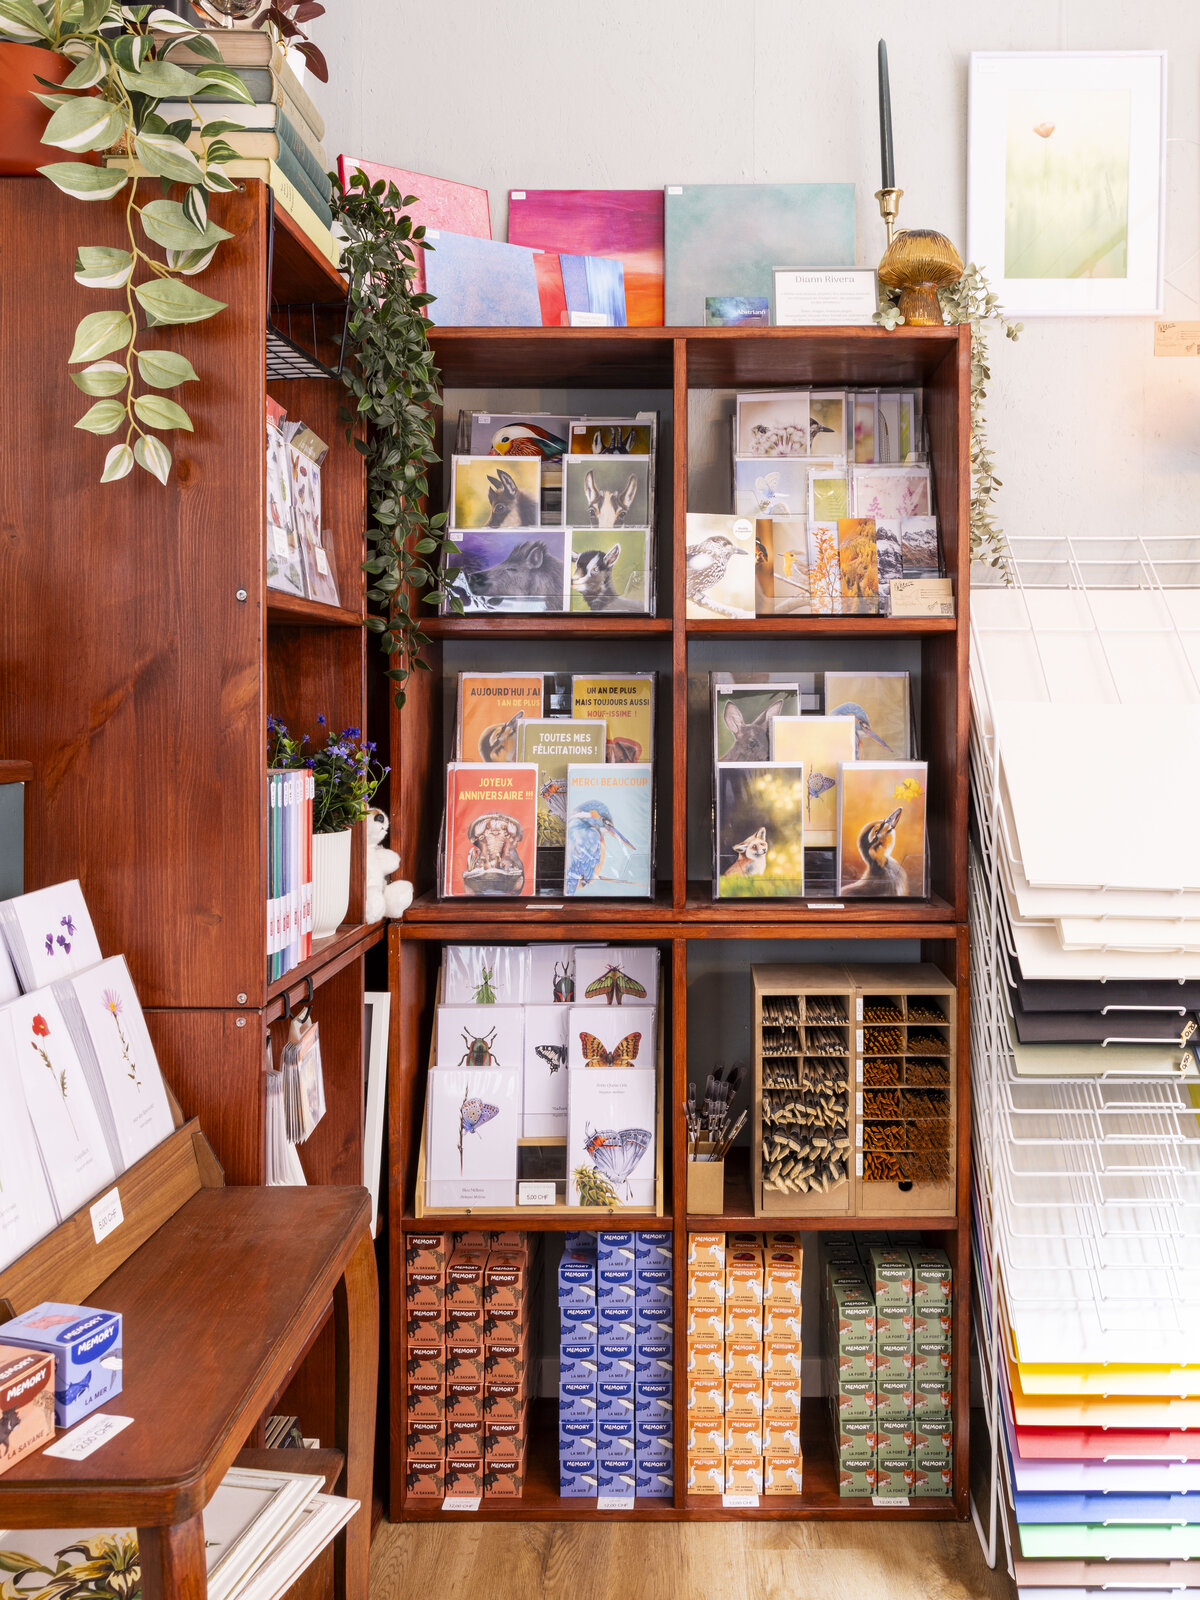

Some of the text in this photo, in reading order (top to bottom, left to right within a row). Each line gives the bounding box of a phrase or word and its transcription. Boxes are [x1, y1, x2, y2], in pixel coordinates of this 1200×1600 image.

[796, 275, 855, 284] Diann Rivera
[470, 688, 540, 696] AUJOURD'HUI J'AI
[540, 733, 591, 742] TOUTES MES
[533, 744, 592, 755] FÉLICITATIONS
[479, 778, 513, 787] JOYEUX
[572, 778, 648, 786] MERCI BEAUCOUP
[458, 791, 524, 800] ANNIVERSAIRE
[63, 1316, 103, 1340] MEMORY
[77, 1325, 115, 1356] MEMORY
[6, 1368, 47, 1402] MEMORY
[84, 1386, 108, 1406] LA MER
[7, 1430, 44, 1460] LA SAVANE
